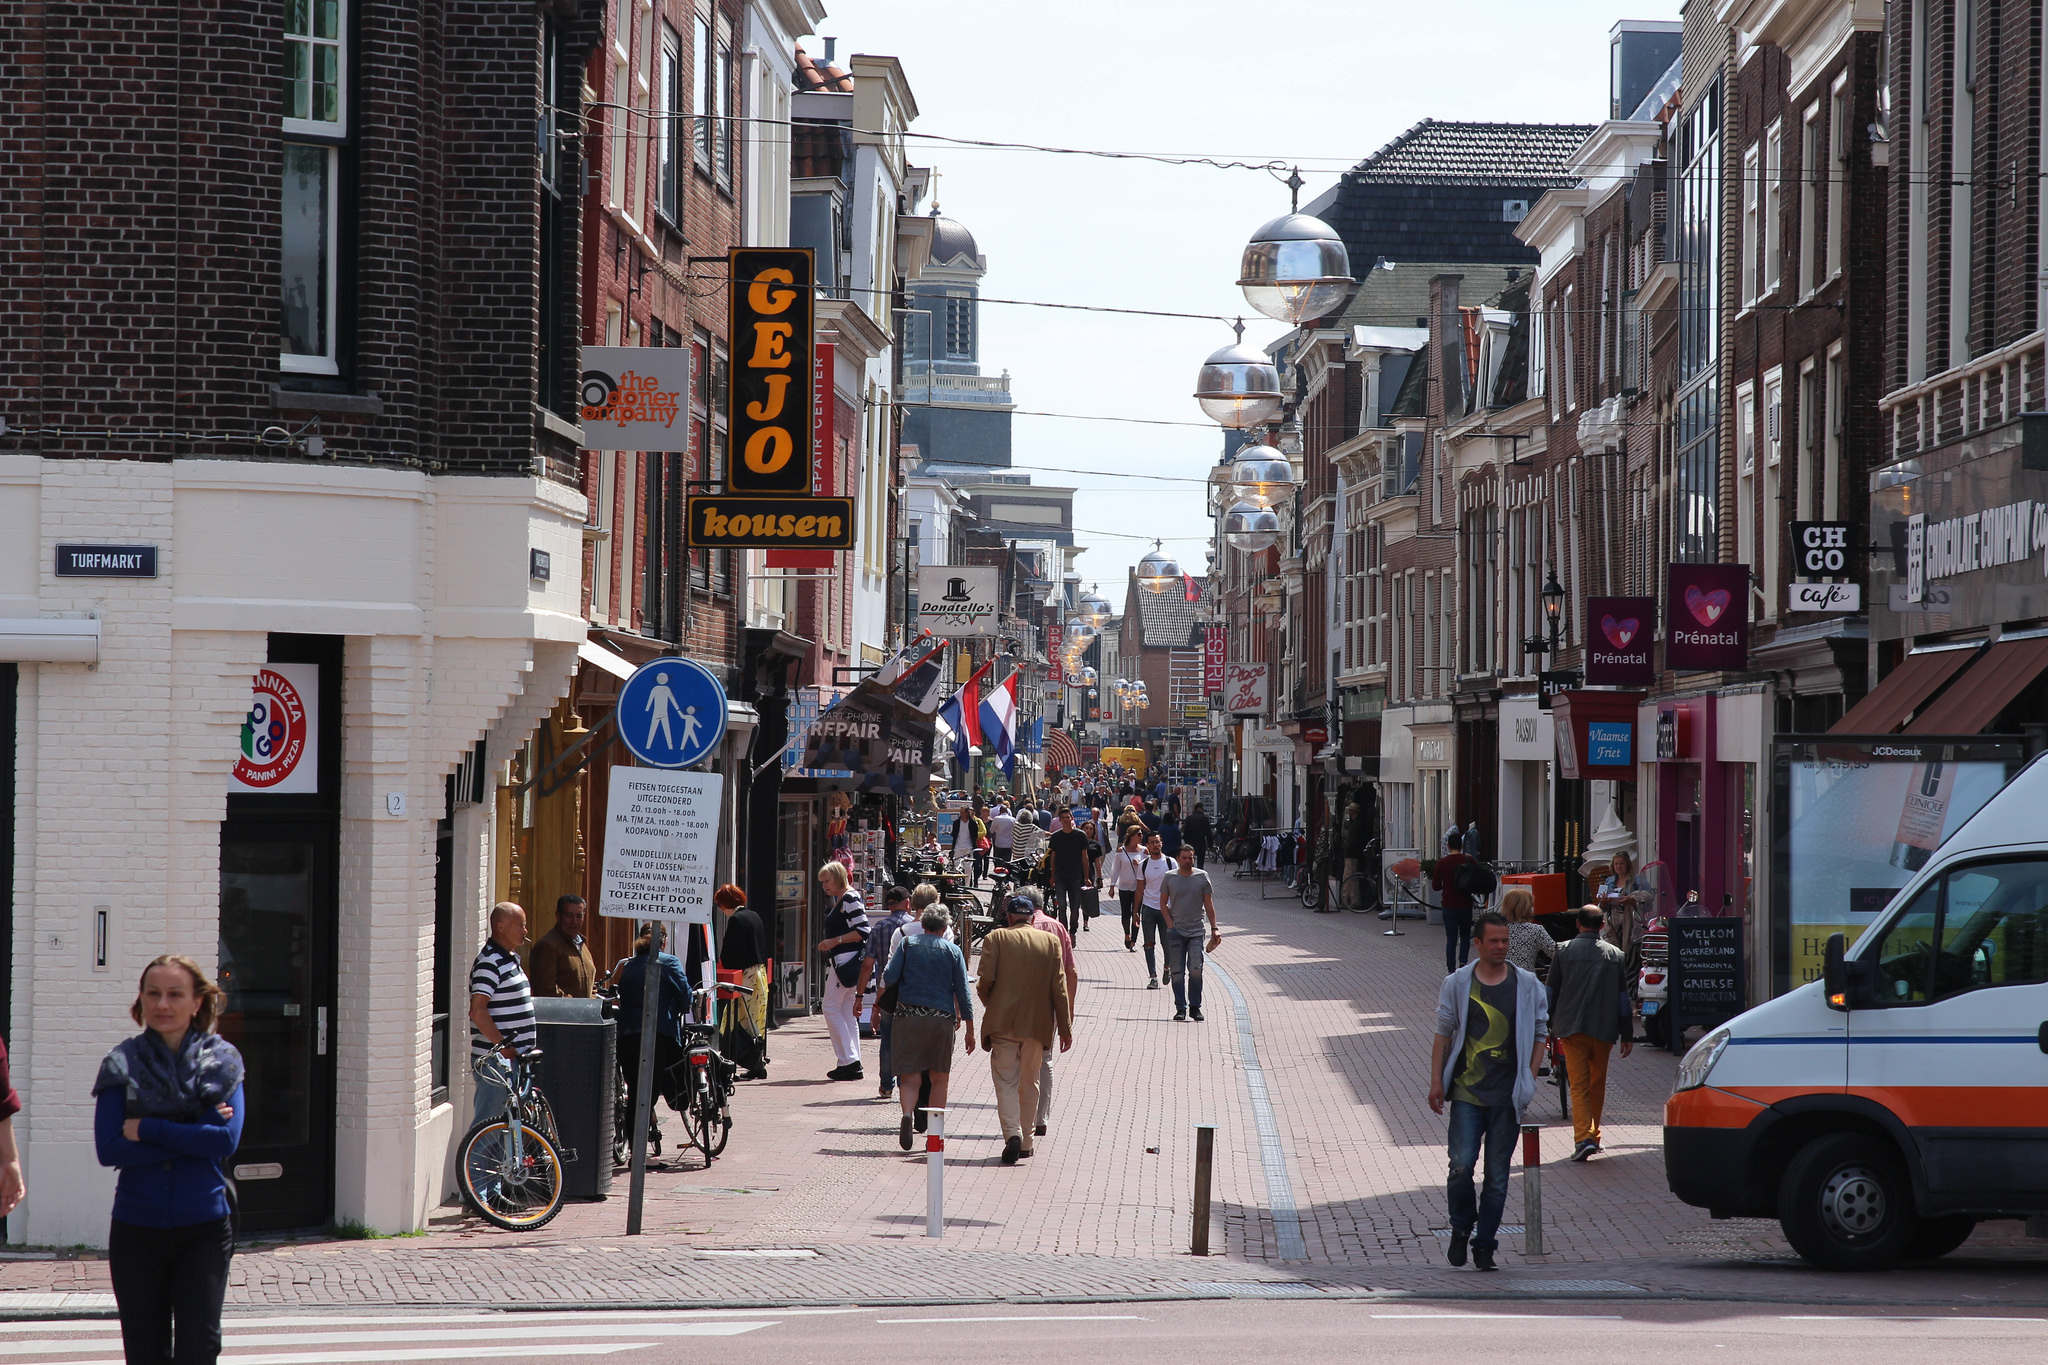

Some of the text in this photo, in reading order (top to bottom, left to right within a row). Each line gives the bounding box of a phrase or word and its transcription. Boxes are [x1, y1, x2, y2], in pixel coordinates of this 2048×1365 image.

[744, 267, 797, 474] GEJO
[620, 370, 658, 391] the
[607, 385, 680, 407] doner
[813, 358, 824, 496] EPAIR CENTER
[703, 507, 842, 538] kousen
[1803, 526, 1847, 548] CH
[1926, 513, 1980, 580] CHOCOLATE
[1981, 499, 2032, 569] COMPANY
[71, 553, 142, 569] TURFMARKT
[1805, 550, 1844, 570] CO
[1799, 585, 1850, 609] café
[921, 602, 995, 613] Donatello's
[1674, 630, 1739, 645] Prénatal
[1207, 627, 1224, 691] ESPRIT
[1593, 652, 1647, 664] Prénatal
[253, 674, 302, 723] NNIZZA
[847, 713, 882, 722] PHONE
[810, 721, 880, 739] REPAIR
[1589, 729, 1629, 742] Vlaamse
[256, 720, 284, 757] GO
[891, 739, 924, 749] PHONE
[1596, 747, 1621, 760] Friet
[1872, 747, 1922, 757] JCDecaux
[246, 739, 301, 781] PANINI PIZZA
[628, 782, 703, 795] FIETSEN TOEGESTAAN
[393, 796, 401, 810] 2
[637, 794, 692, 805] UITGEZONDERD
[1906, 796, 1944, 812] CLINIQUE
[631, 805, 643, 813] ZO.
[644, 807, 667, 815] 13.00h
[673, 809, 696, 817] 18.00h
[616, 815, 629, 823] MA.
[645, 817, 656, 825] ZA.
[658, 819, 680, 827] 11.00h
[686, 821, 709, 829] 18.00h
[625, 827, 669, 837] KOOPAVOND
[620, 848, 697, 861] ONMIDDELLIJK LADEN
[633, 860, 643, 869] EN
[644, 861, 654, 869] OF
[655, 862, 683, 871] LOSSEN
[606, 869, 651, 880] TOEGESTAAN
[652, 873, 667, 882] VAN
[698, 877, 710, 885] ZA.
[618, 881, 645, 891] TUSSEN
[608, 890, 703, 905] TOEZICHT DOOR
[628, 902, 686, 914] BIKETEAM
[1682, 928, 1734, 939] WELKOM
[1679, 947, 1736, 956] GRIEKENLAND
[1683, 979, 1734, 989] GRIEKSE
